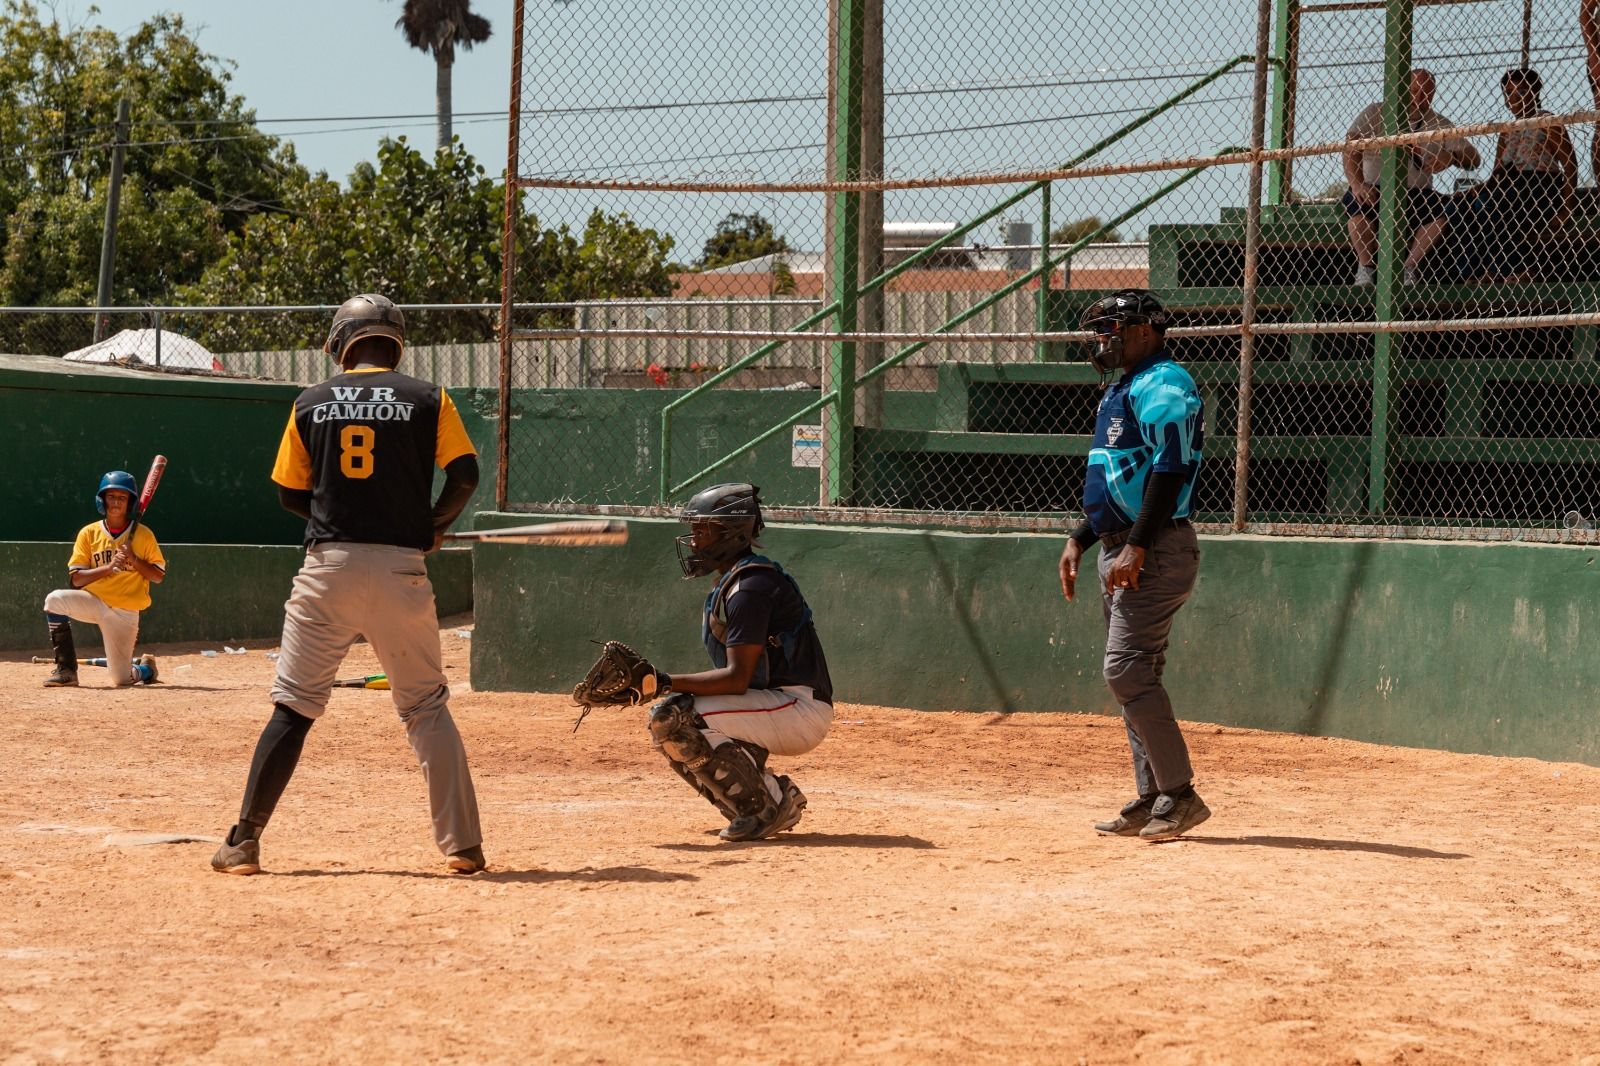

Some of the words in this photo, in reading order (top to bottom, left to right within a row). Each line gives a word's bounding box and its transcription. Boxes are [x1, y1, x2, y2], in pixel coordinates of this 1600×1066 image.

[331, 387, 364, 402] W
[369, 387, 397, 402] R
[312, 403, 414, 424] CAMION
[340, 425, 375, 479] 8
